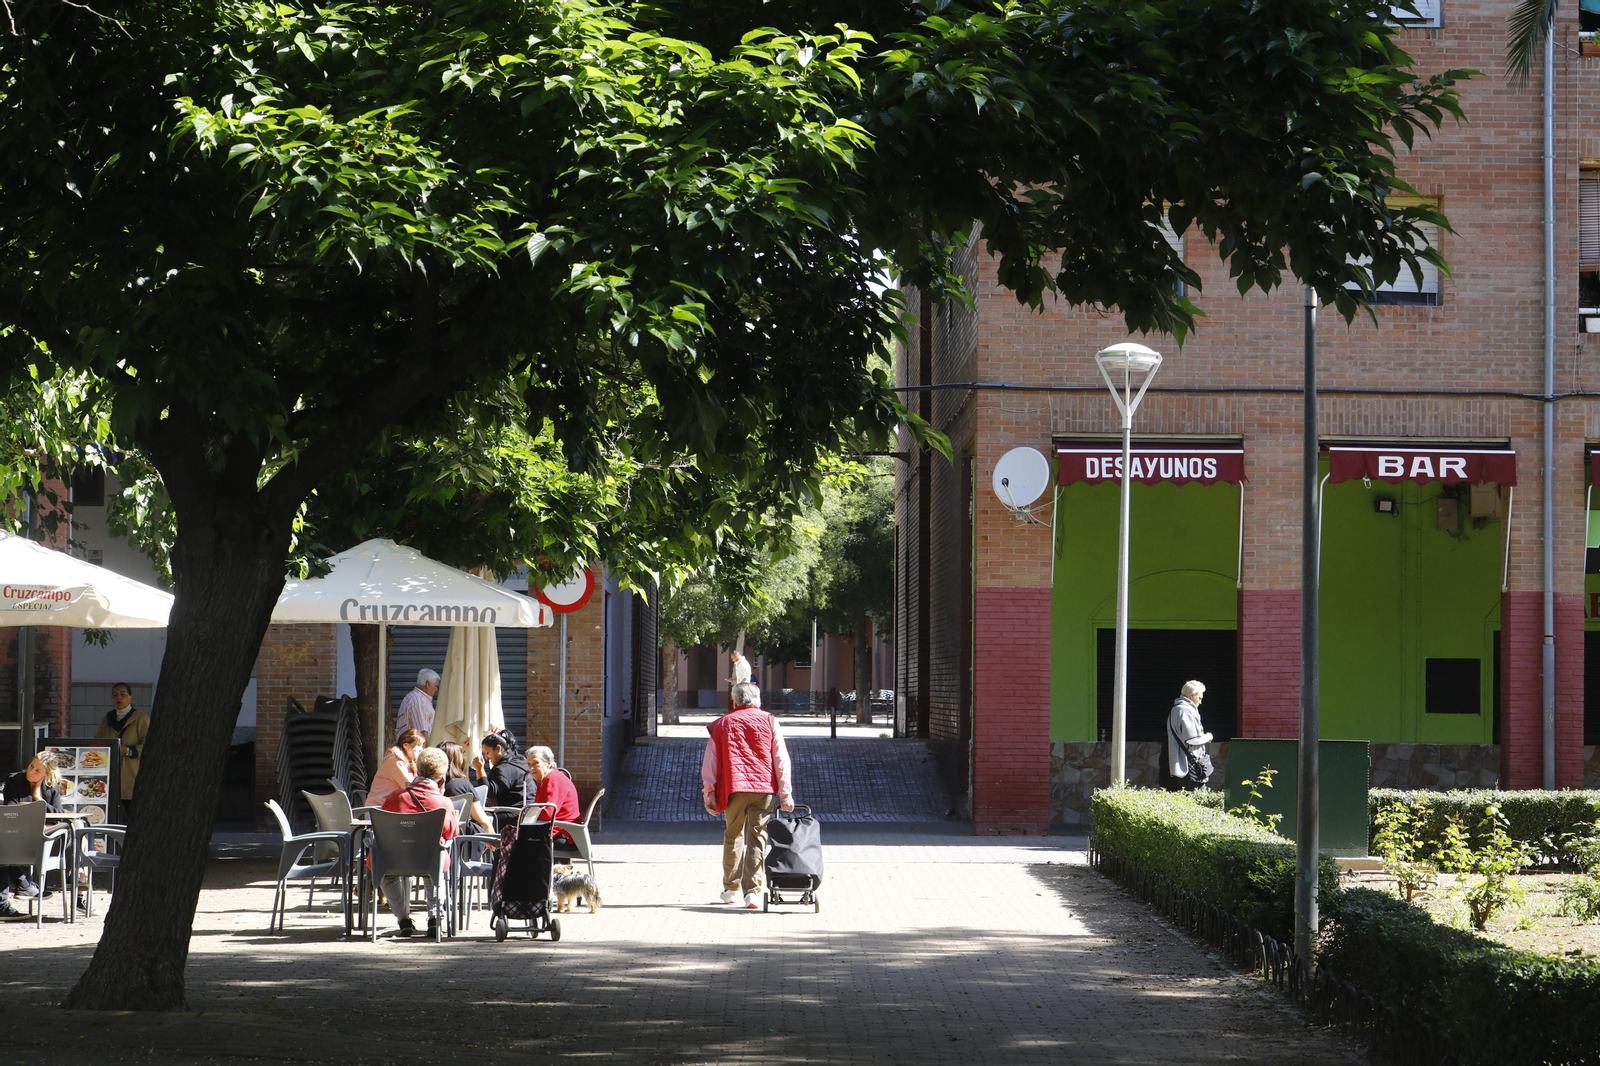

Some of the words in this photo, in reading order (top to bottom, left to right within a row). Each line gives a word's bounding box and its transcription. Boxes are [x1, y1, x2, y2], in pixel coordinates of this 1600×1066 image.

[1086, 457, 1217, 479] DESAYUNOS
[1378, 455, 1468, 479] BAR
[3, 585, 72, 602] Cruzcampo
